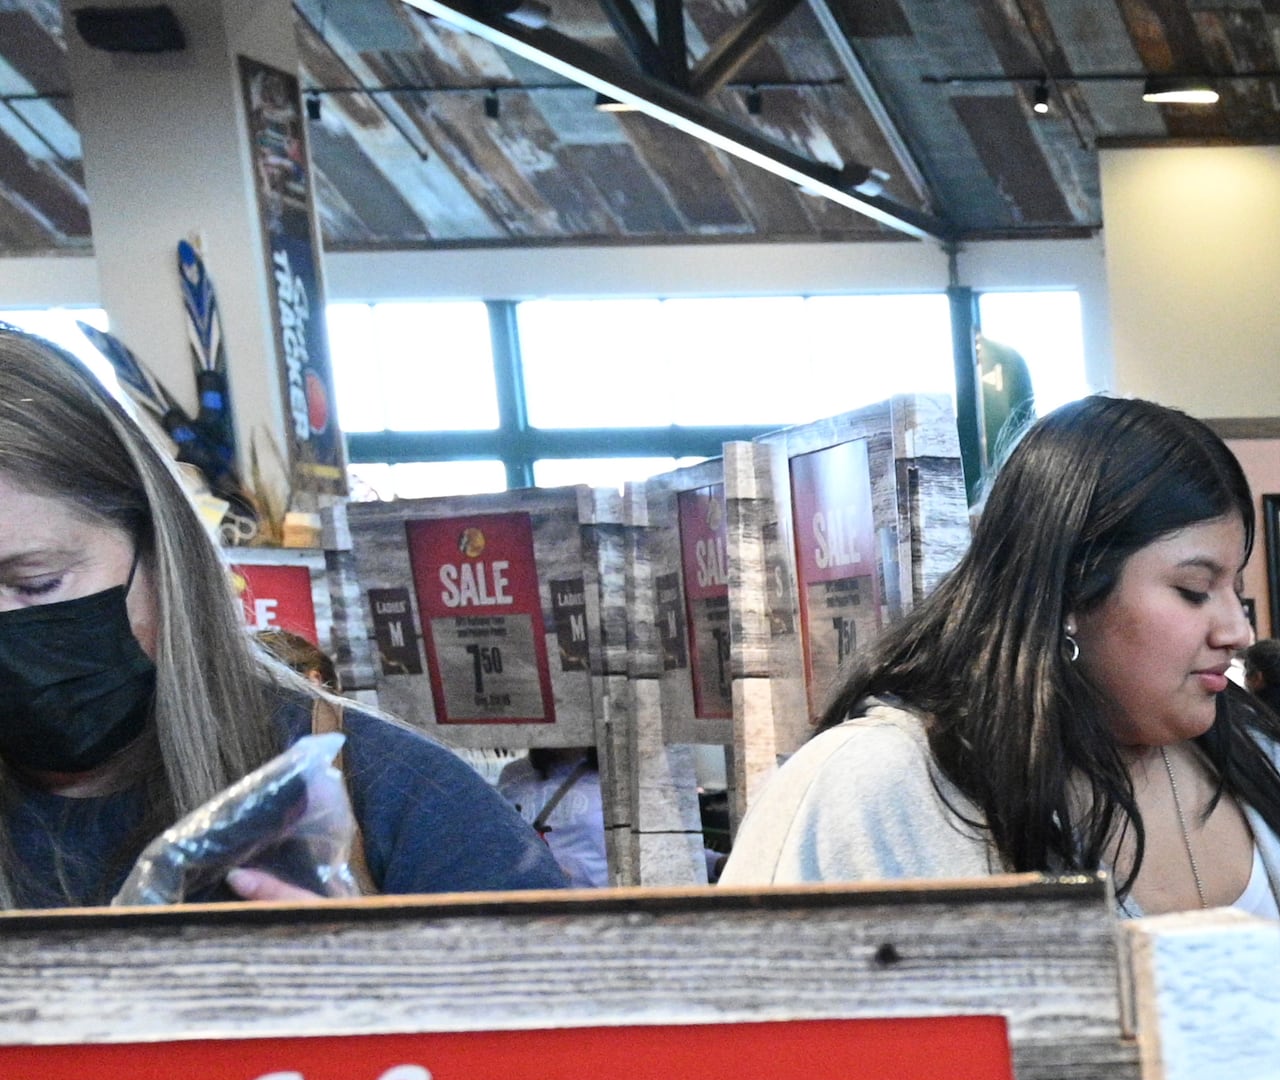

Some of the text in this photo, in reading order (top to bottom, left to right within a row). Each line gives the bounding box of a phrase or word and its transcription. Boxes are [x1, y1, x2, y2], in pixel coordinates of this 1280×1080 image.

[274, 249, 309, 441] TRACKER
[812, 505, 861, 569] SALE
[439, 560, 514, 608] SALE
[696, 537, 729, 588] SAL
[234, 598, 282, 632] LE
[388, 620, 405, 647] M
